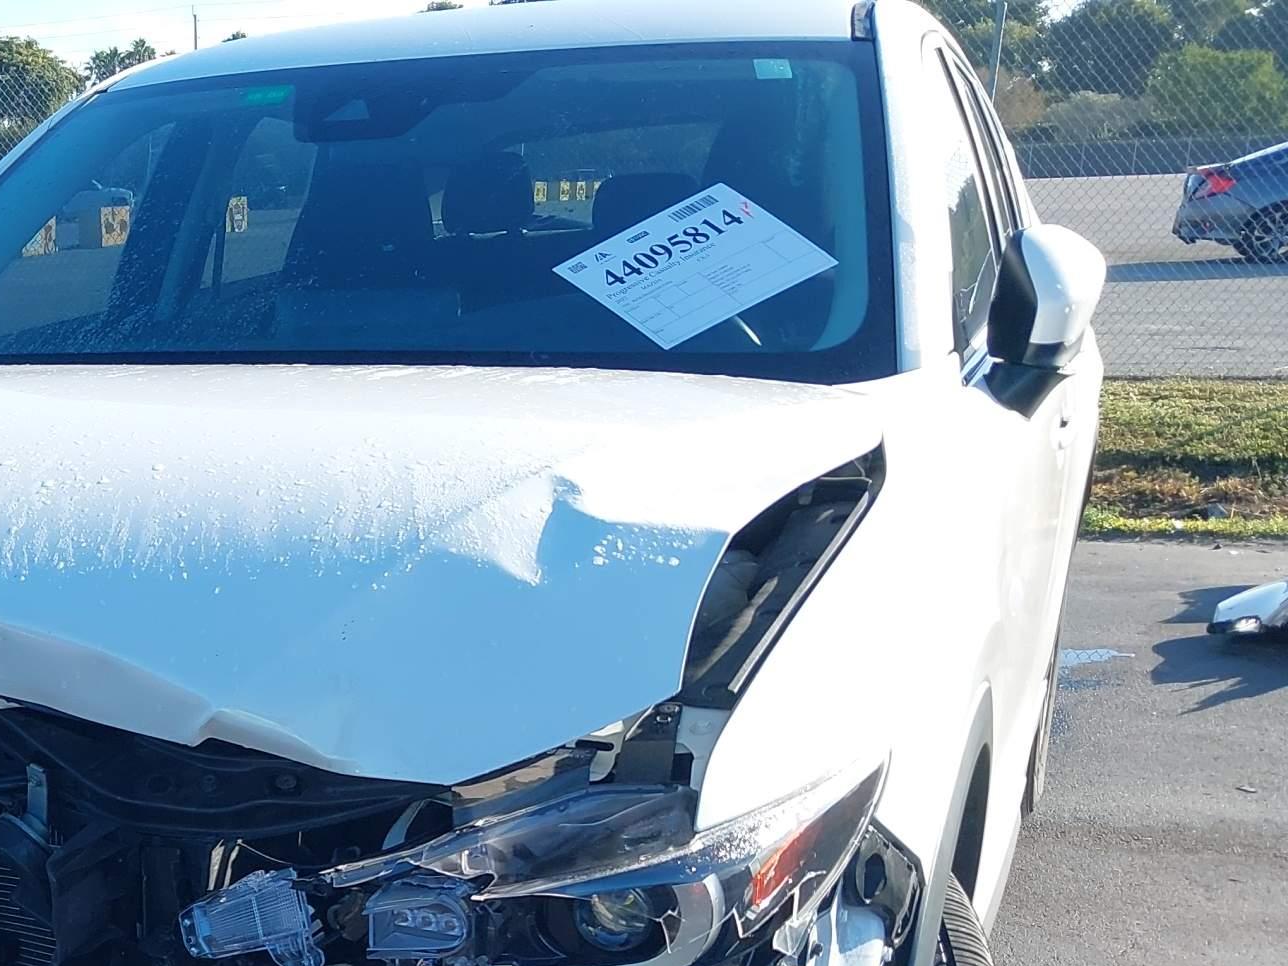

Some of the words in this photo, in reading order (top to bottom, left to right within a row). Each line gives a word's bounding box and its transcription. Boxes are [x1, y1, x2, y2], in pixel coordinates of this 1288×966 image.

[604, 208, 745, 288] 44095814
[605, 275, 651, 300] Progressive
[648, 258, 682, 278] Casualty
[681, 242, 716, 263] Insurance
